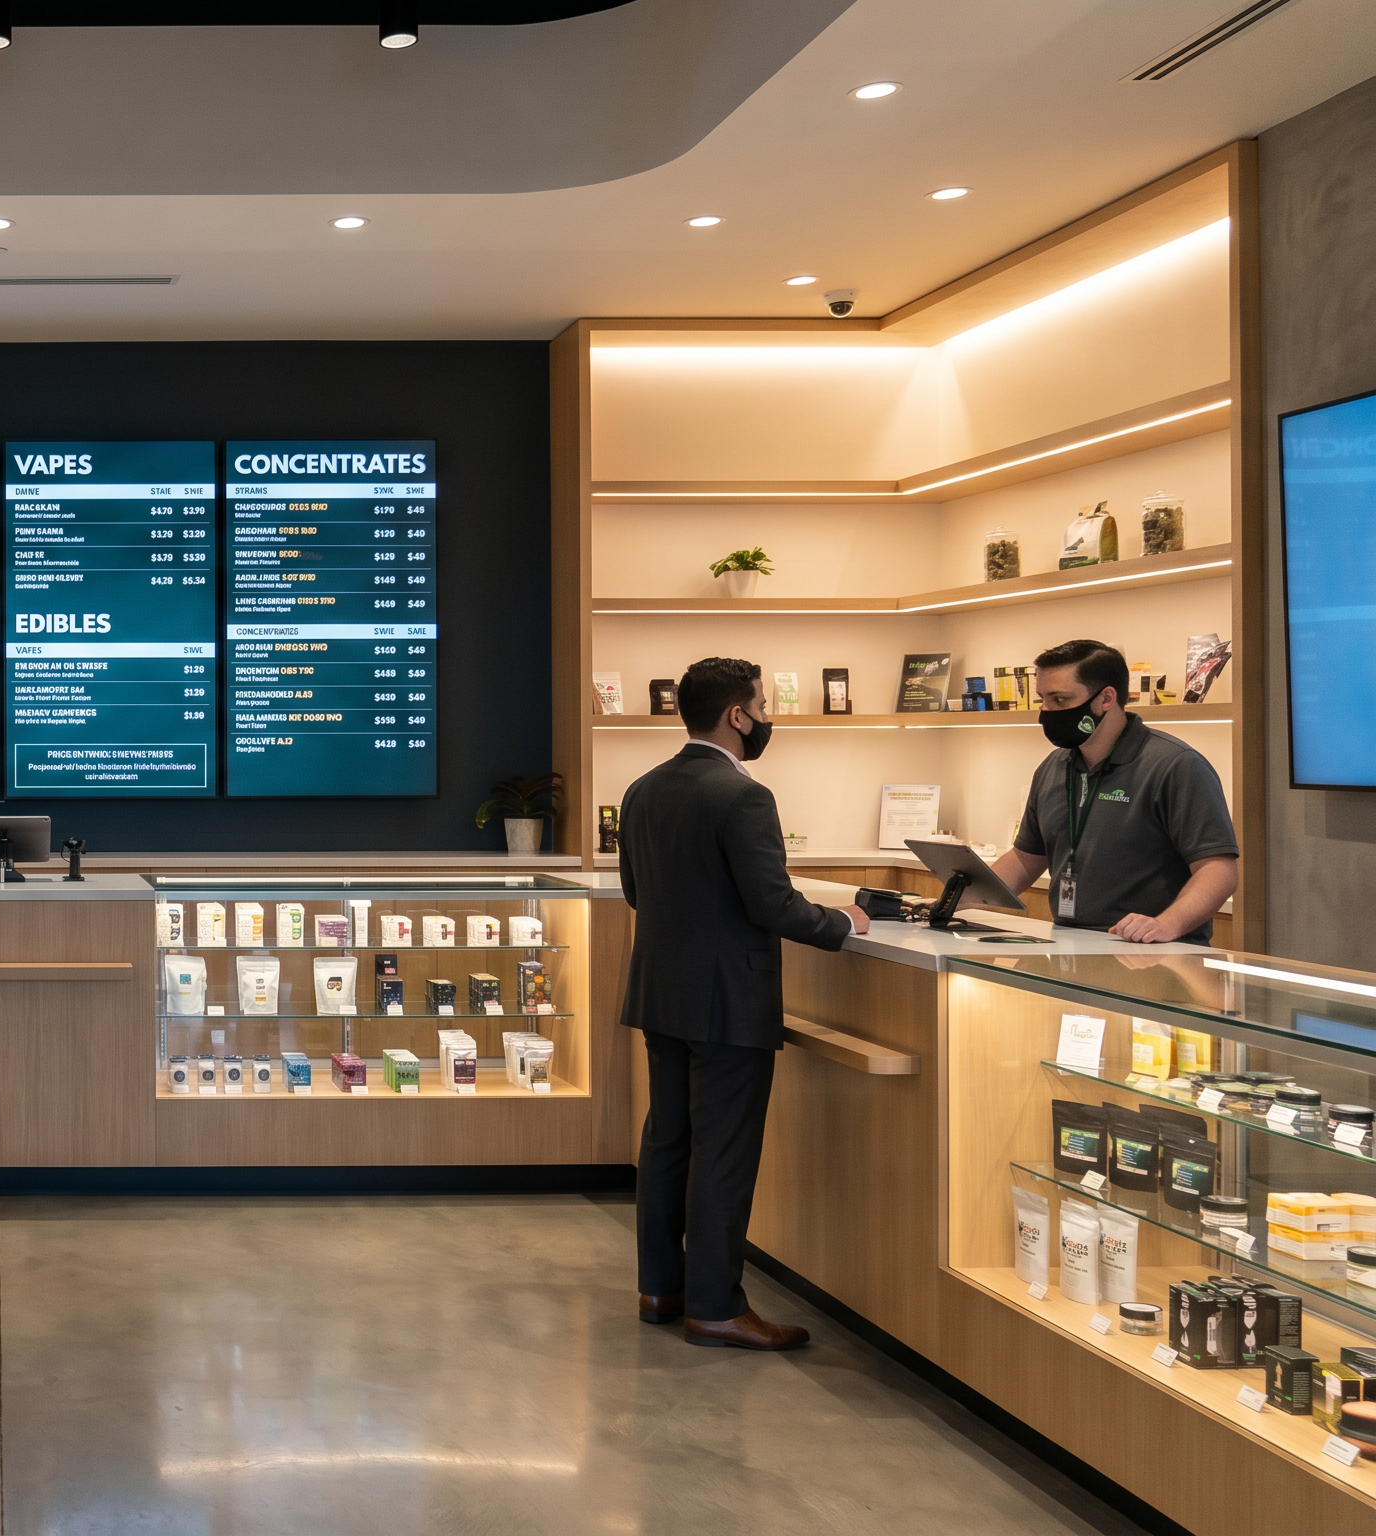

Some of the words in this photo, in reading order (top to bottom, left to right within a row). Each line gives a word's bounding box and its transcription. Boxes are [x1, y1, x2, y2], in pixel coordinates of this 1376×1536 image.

[14, 454, 92, 474] VAPES
[235, 454, 426, 474] CONCENTRATES
[16, 614, 111, 633] EDIBLES
